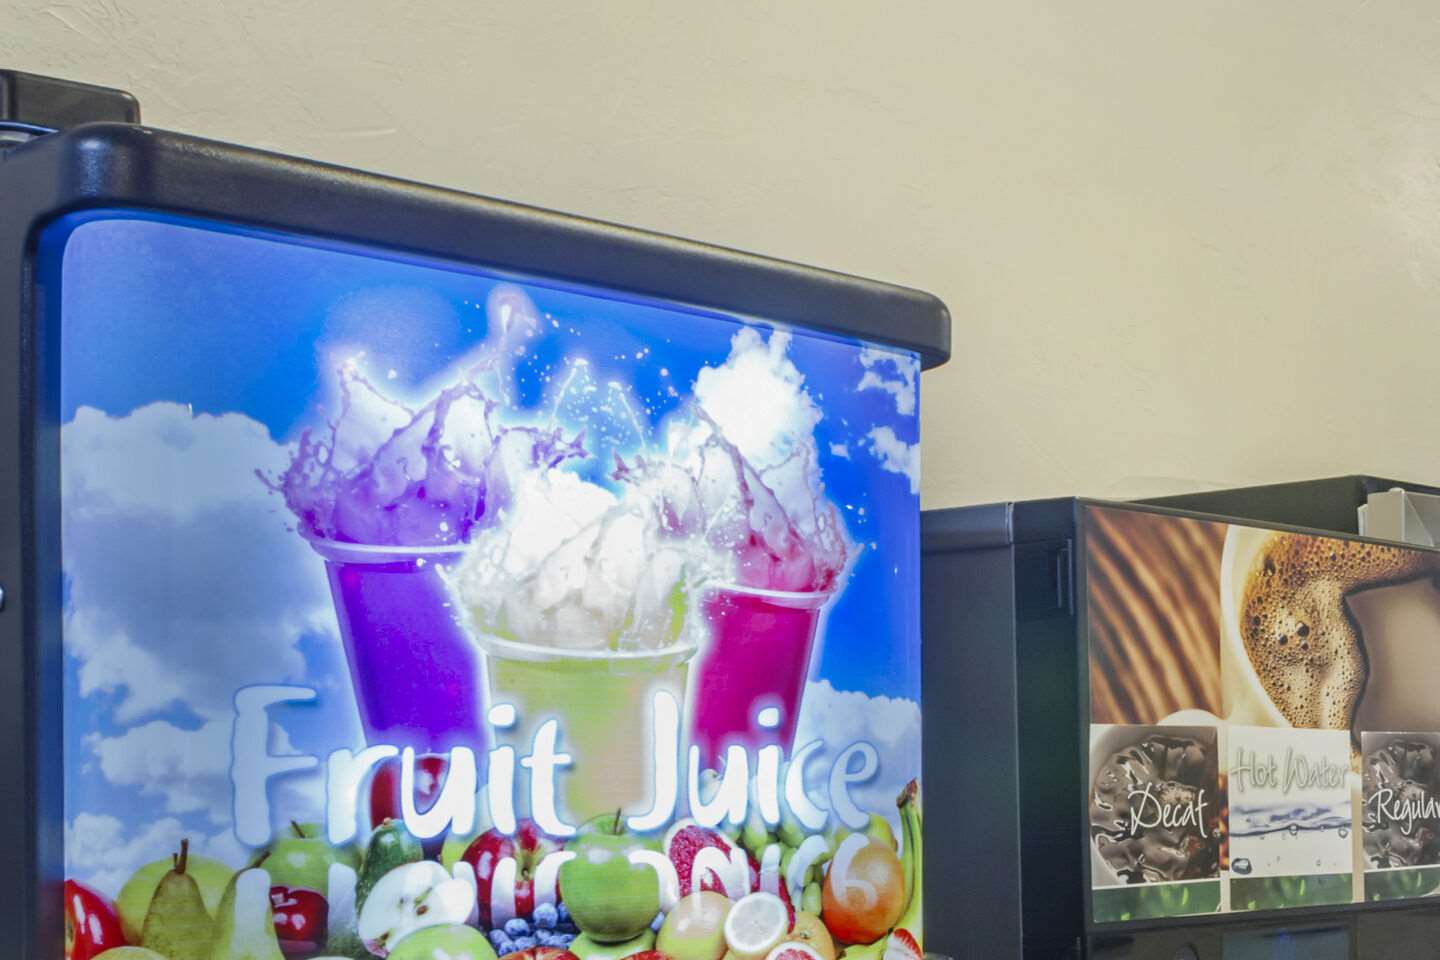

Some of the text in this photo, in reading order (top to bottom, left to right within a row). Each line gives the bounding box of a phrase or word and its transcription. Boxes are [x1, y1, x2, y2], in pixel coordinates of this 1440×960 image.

[231, 685, 880, 846] Fruit Juice
[1229, 746, 1350, 795] Hot Water
[1127, 782, 1209, 838] Decaf
